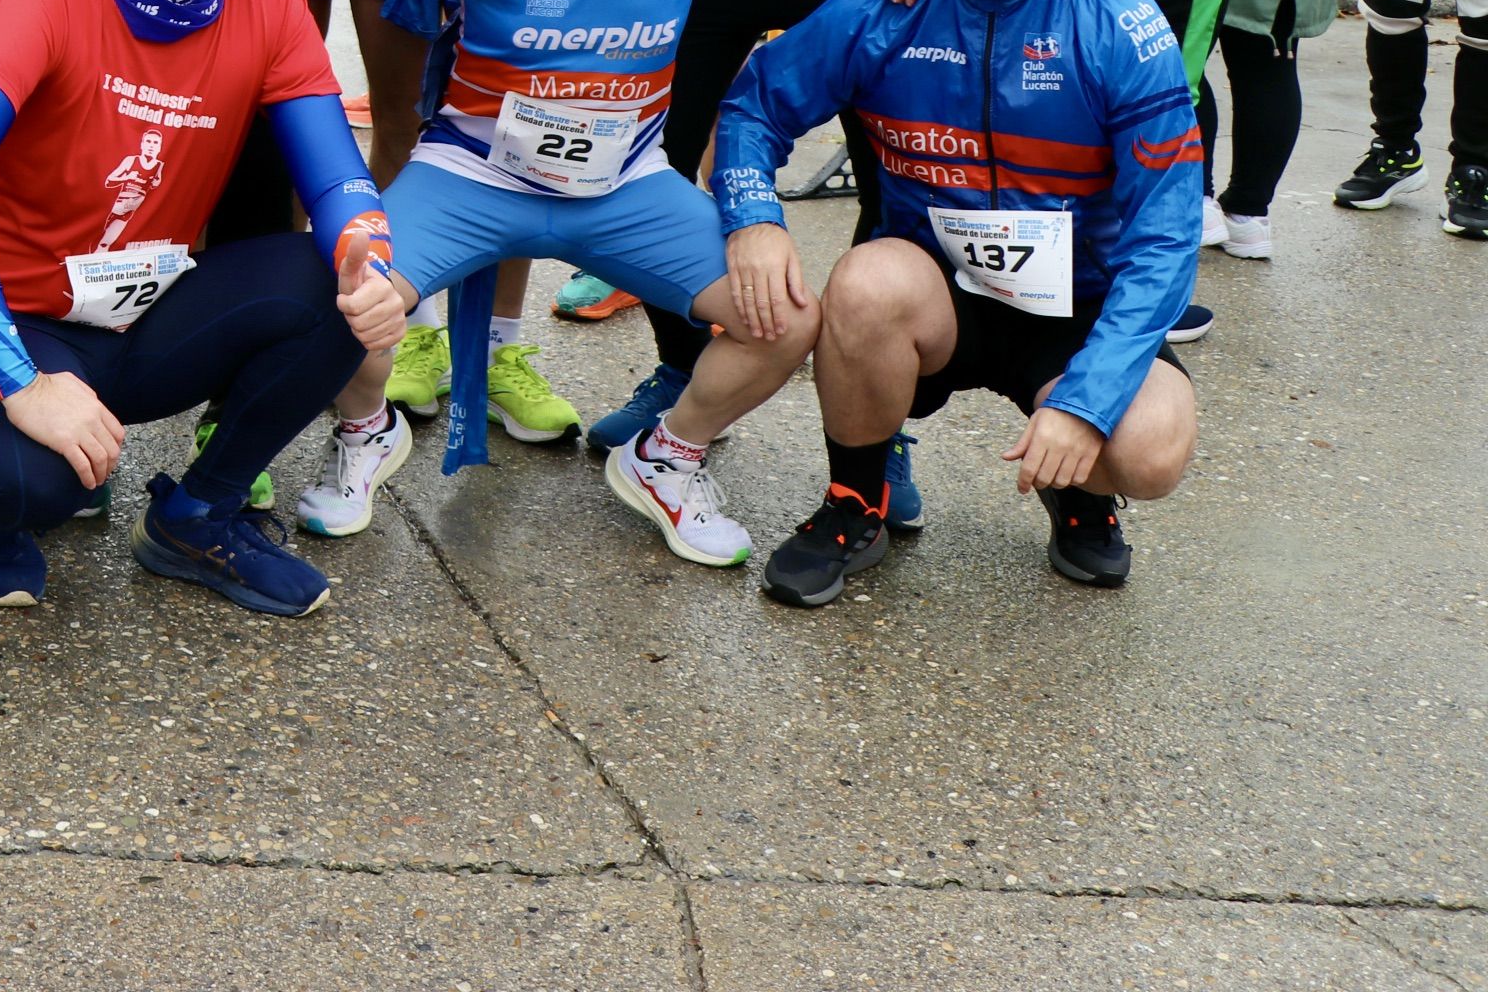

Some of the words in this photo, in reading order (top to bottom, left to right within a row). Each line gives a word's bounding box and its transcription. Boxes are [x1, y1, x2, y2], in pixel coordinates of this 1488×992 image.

[1118, 2, 1154, 31] Club
[512, 18, 676, 55] enerplus
[902, 46, 967, 65] nerplus
[1022, 61, 1045, 71] Club
[1022, 70, 1064, 81] Maratón
[1022, 81, 1060, 91] Lucena
[103, 73, 112, 90] I
[112, 77, 137, 98] San
[138, 85, 191, 110] Silvestr
[529, 75, 650, 100] Maratón
[118, 98, 164, 125] Ciudad
[164, 111, 183, 129] de
[515, 113, 544, 127] Ciudad
[545, 120, 555, 129] de
[556, 123, 585, 134] Lucena
[518, 105, 533, 116] San
[534, 110, 570, 125] Silvestre
[536, 133, 593, 163] 22
[877, 120, 979, 158] Maratón
[881, 148, 968, 186] Lucena
[943, 219, 956, 227] San
[957, 220, 991, 231] Silvestre
[944, 226, 968, 237] Ciudad
[970, 230, 979, 238] de
[980, 231, 1009, 239] Lucena
[84, 265, 101, 274] San
[102, 262, 136, 273] Silvestre
[963, 242, 1035, 273] 137
[85, 273, 114, 284] Ciudad
[115, 272, 125, 280] de
[126, 270, 151, 279] Lucena
[112, 281, 159, 311] 72
[1019, 291, 1056, 300] enerplus
